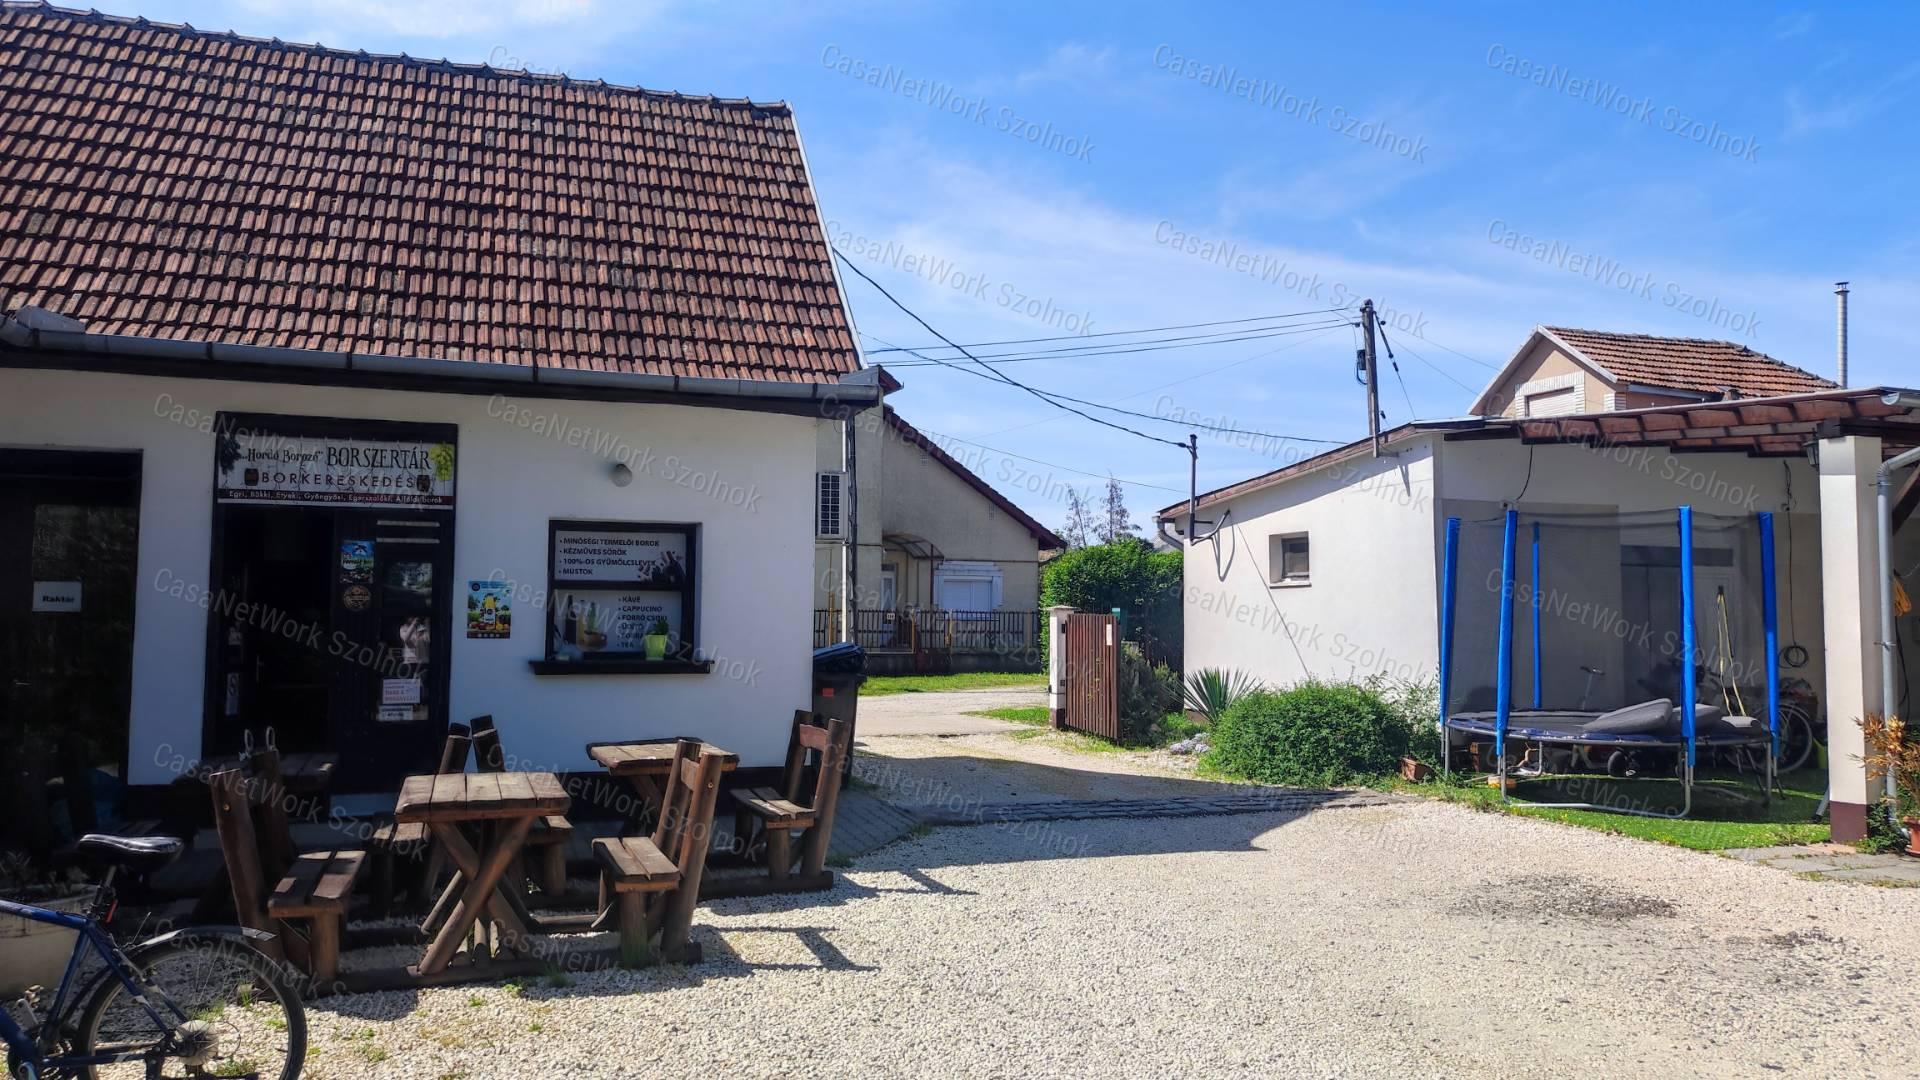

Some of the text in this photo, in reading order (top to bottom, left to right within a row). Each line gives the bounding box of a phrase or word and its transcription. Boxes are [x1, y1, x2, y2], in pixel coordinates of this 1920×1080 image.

[327, 446, 432, 469] BORSZERTÁR
[262, 472, 415, 488] BORKERESKEDÉS
[602, 548, 628, 556] SÖRÖK
[562, 568, 593, 576] MUSTOK
[622, 605, 663, 613] CAPPUCINO
[622, 614, 646, 622] FORRÓ
